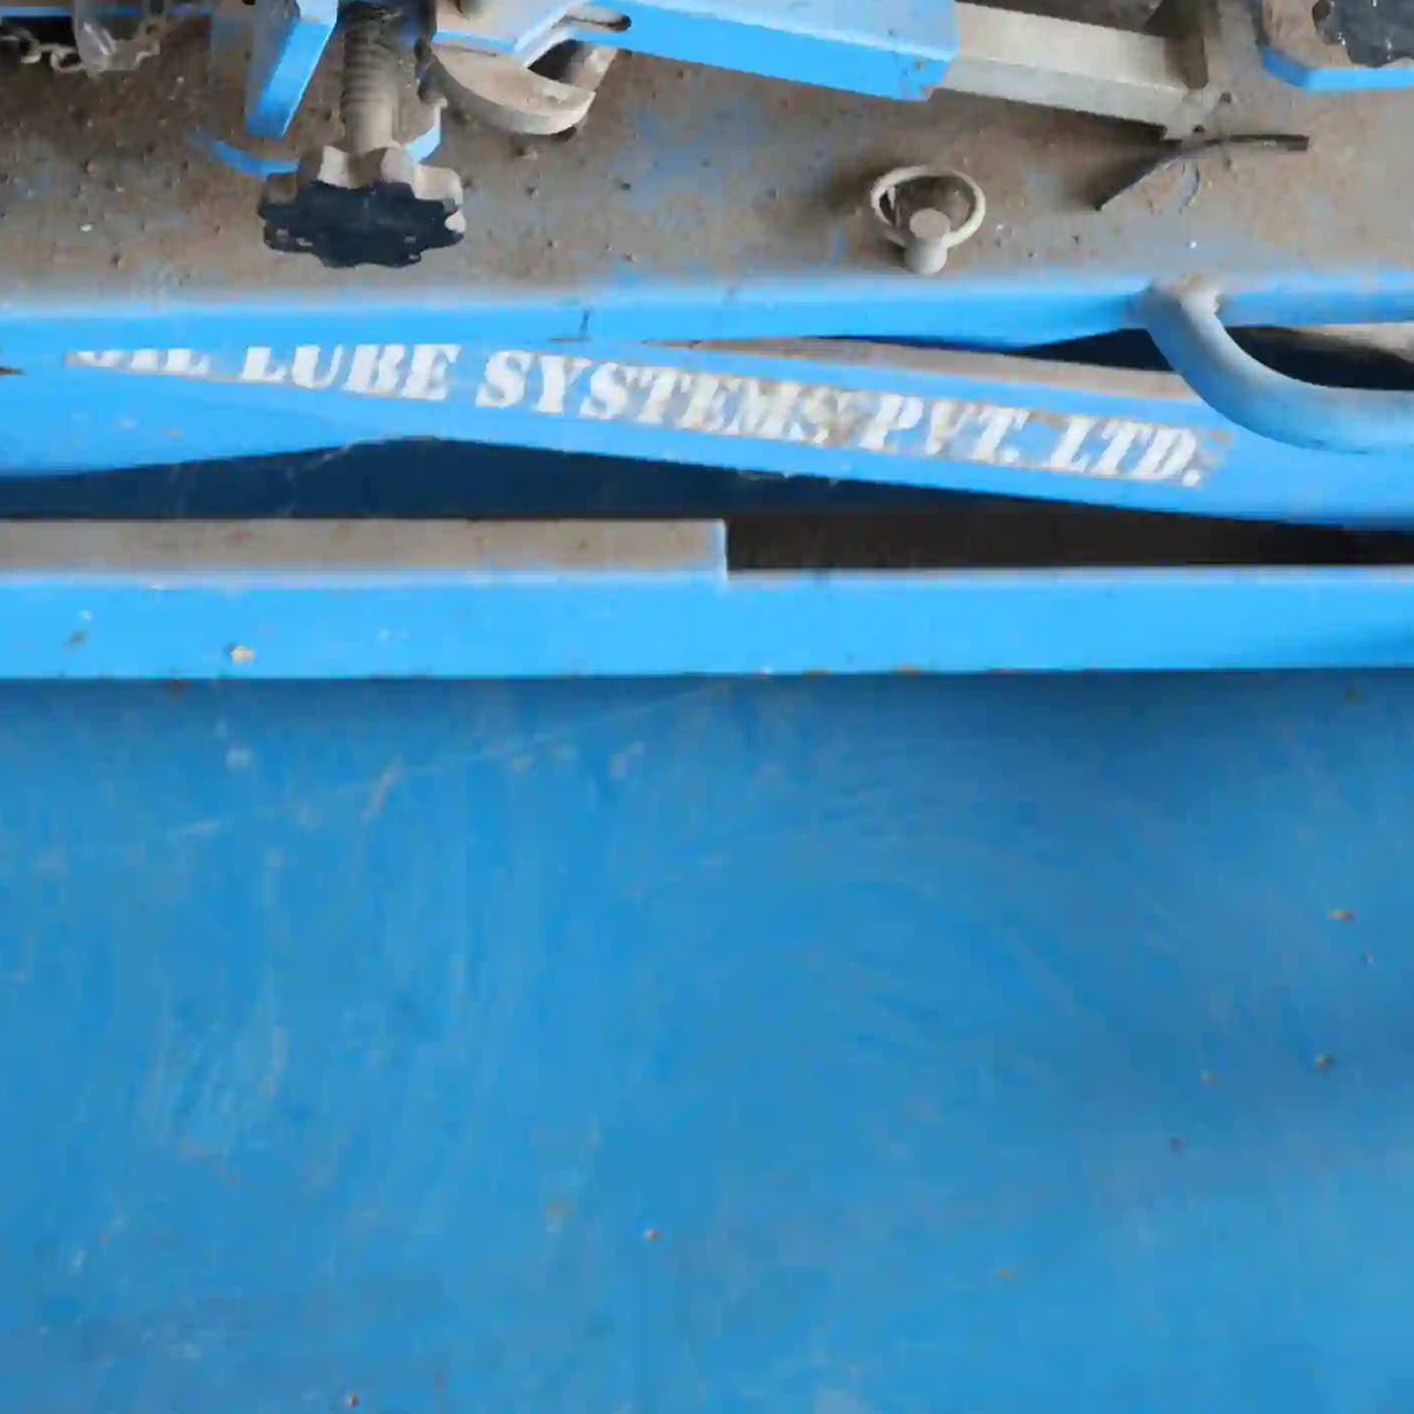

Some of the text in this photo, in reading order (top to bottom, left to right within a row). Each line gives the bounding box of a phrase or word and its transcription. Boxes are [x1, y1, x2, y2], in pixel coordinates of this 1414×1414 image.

[241, 343, 463, 401] LUBE
[475, 349, 842, 445] SYSTEMS
[1050, 413, 1200, 487] LTD.
